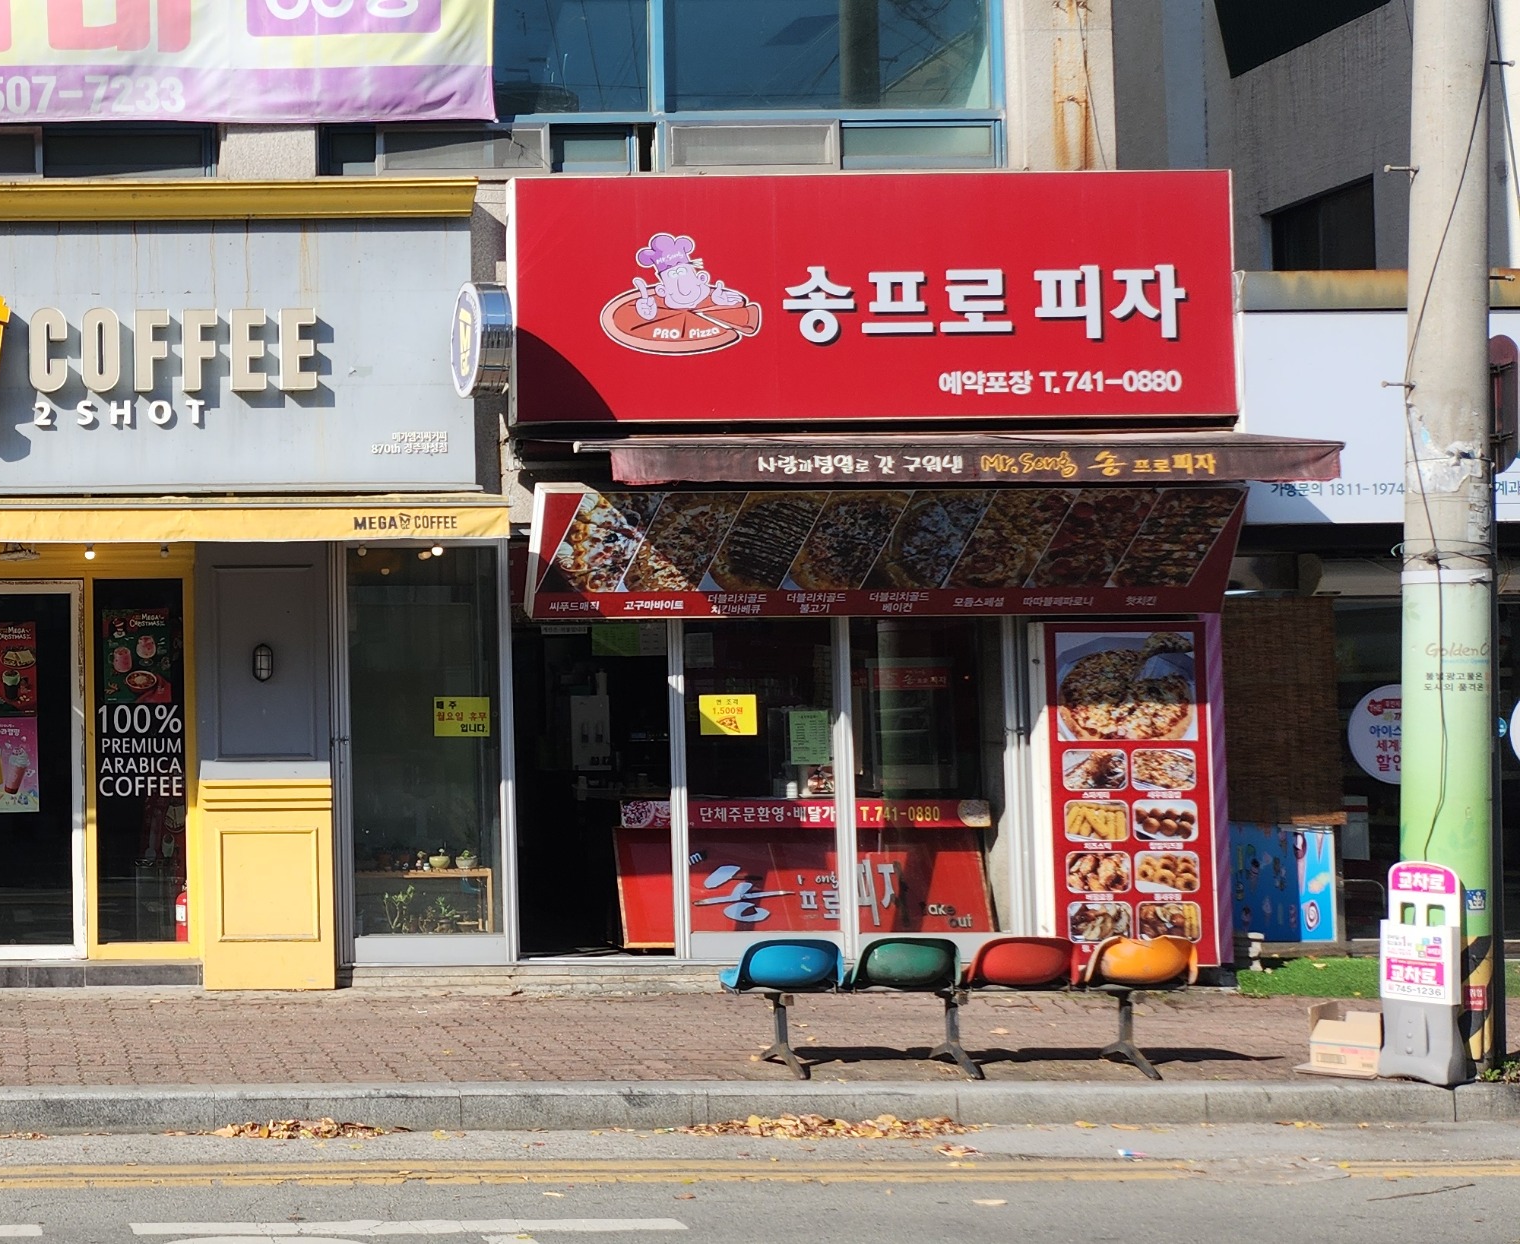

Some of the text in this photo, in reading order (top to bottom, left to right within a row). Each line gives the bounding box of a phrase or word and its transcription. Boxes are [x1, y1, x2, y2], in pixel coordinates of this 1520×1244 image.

[782, 264, 1186, 344] 송프로 피자
[653, 327, 720, 340] PRO Pizza
[29, 306, 318, 394] COFFEE
[938, 369, 1183, 397] 예약포장 T.741-0880
[34, 401, 54, 426] 2
[75, 400, 206, 426] SHOT
[371, 443, 402, 454] 870th
[874, 454, 895, 475] 갓
[1270, 482, 1405, 498] 가맹문의 1811-1974
[353, 515, 458, 531] MEGA COFFEE
[623, 600, 684, 611] 고구마바이트
[710, 604, 761, 615] 치킨바베큐
[799, 603, 831, 614] 불고기
[882, 602, 913, 613] 베이컨
[98, 704, 182, 734] 100%
[436, 711, 464, 721] 월요일
[101, 738, 182, 754] PREMIUM
[1376, 739, 1402, 752] 세계
[100, 757, 182, 774] ARABICA
[99, 777, 183, 797] COFFEE
[860, 805, 941, 823] T.741-0880
[1398, 871, 1446, 891] 교차로
[1390, 964, 1438, 985] 교차로
[1396, 984, 1442, 997] 745-1236
